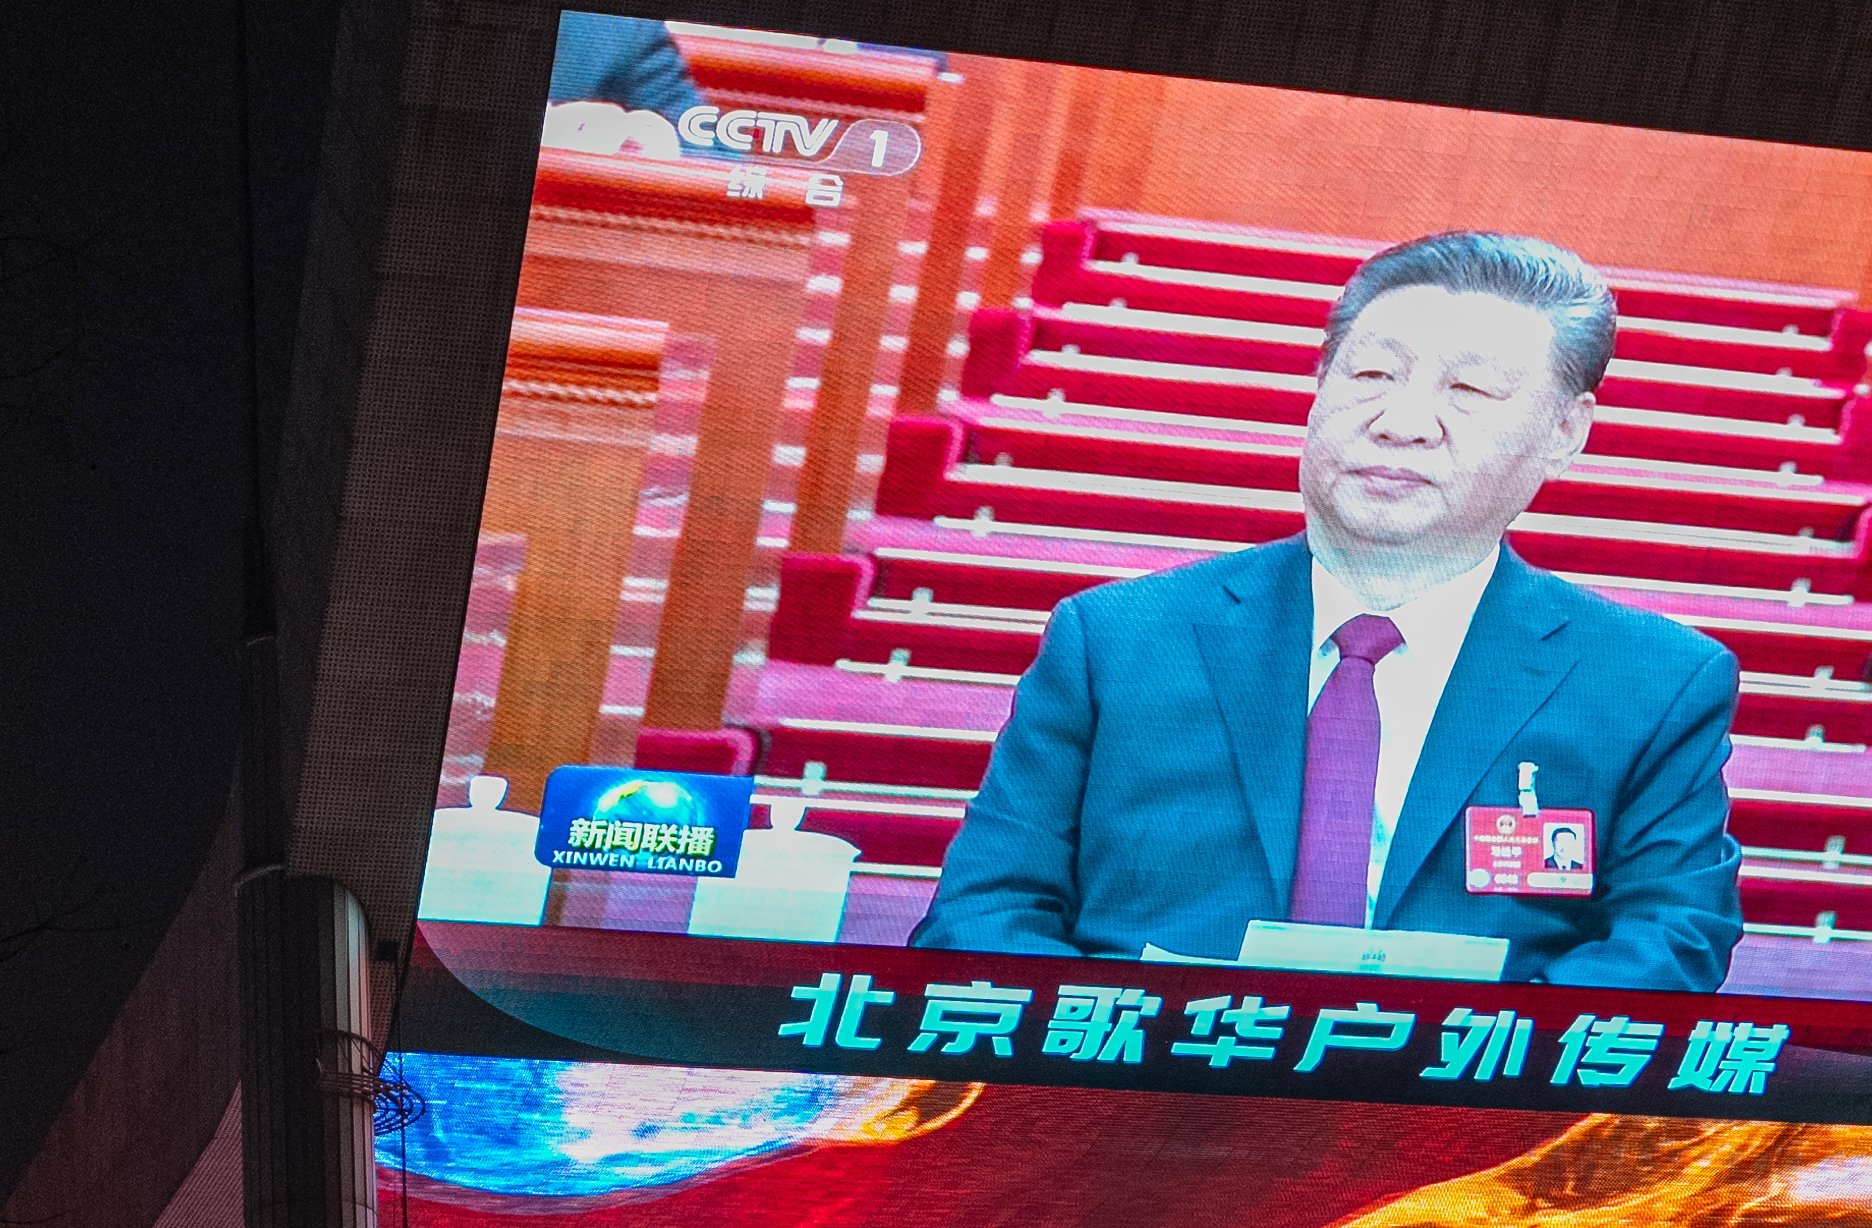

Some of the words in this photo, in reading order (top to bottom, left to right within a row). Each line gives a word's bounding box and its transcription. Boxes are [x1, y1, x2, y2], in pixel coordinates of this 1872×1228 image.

[678, 106, 839, 156] CCTV
[869, 130, 888, 168] 1
[552, 850, 635, 868] XINWEN
[647, 856, 723, 873] LIANBO
[568, 818, 715, 857] 新闻联播
[778, 974, 1790, 1095] 北京歌华户外传媒
